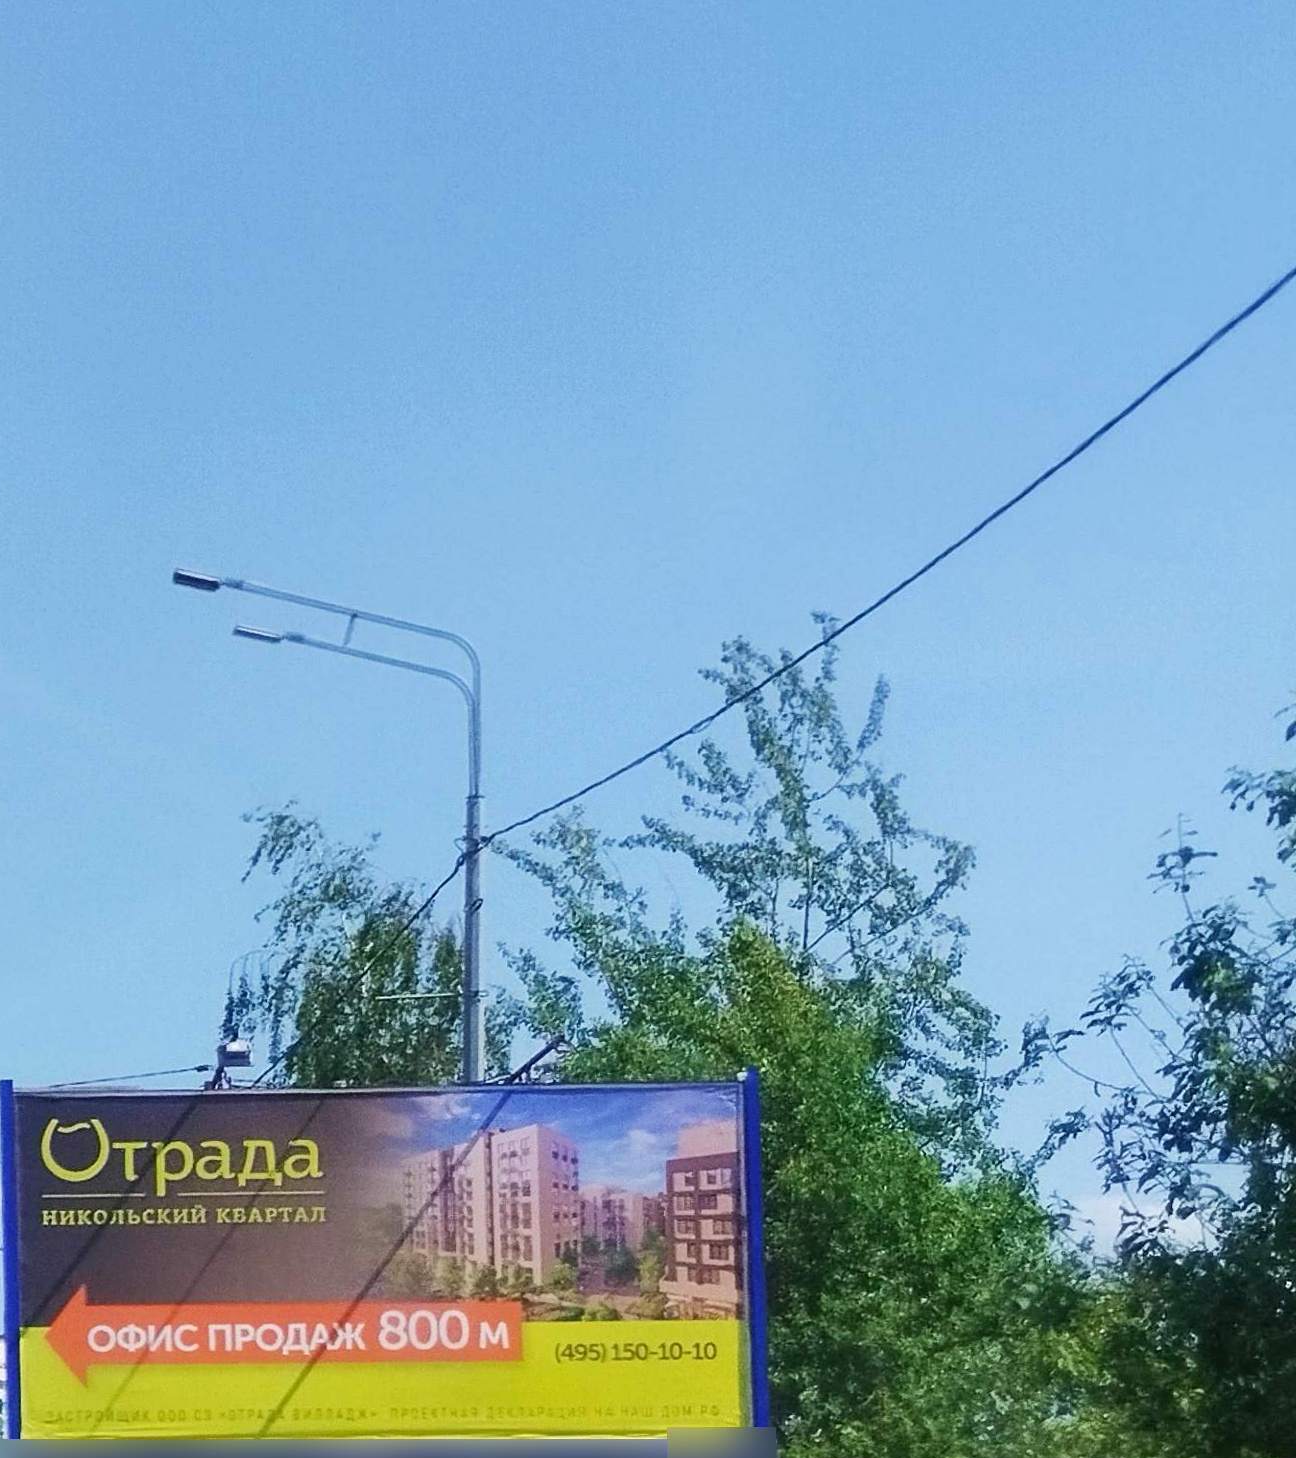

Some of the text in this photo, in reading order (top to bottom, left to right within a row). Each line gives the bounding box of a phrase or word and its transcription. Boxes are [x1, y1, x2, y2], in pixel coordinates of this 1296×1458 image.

[40, 1118, 325, 1197] Отрада
[41, 1204, 327, 1226] НИКОЛЬСКИЙ КВАРТАЛ
[87, 1323, 199, 1353] ОФИС
[207, 1322, 367, 1355] ПРОДАЖ
[378, 1309, 470, 1351] 800
[555, 1342, 717, 1364] (495) 150-10-10
